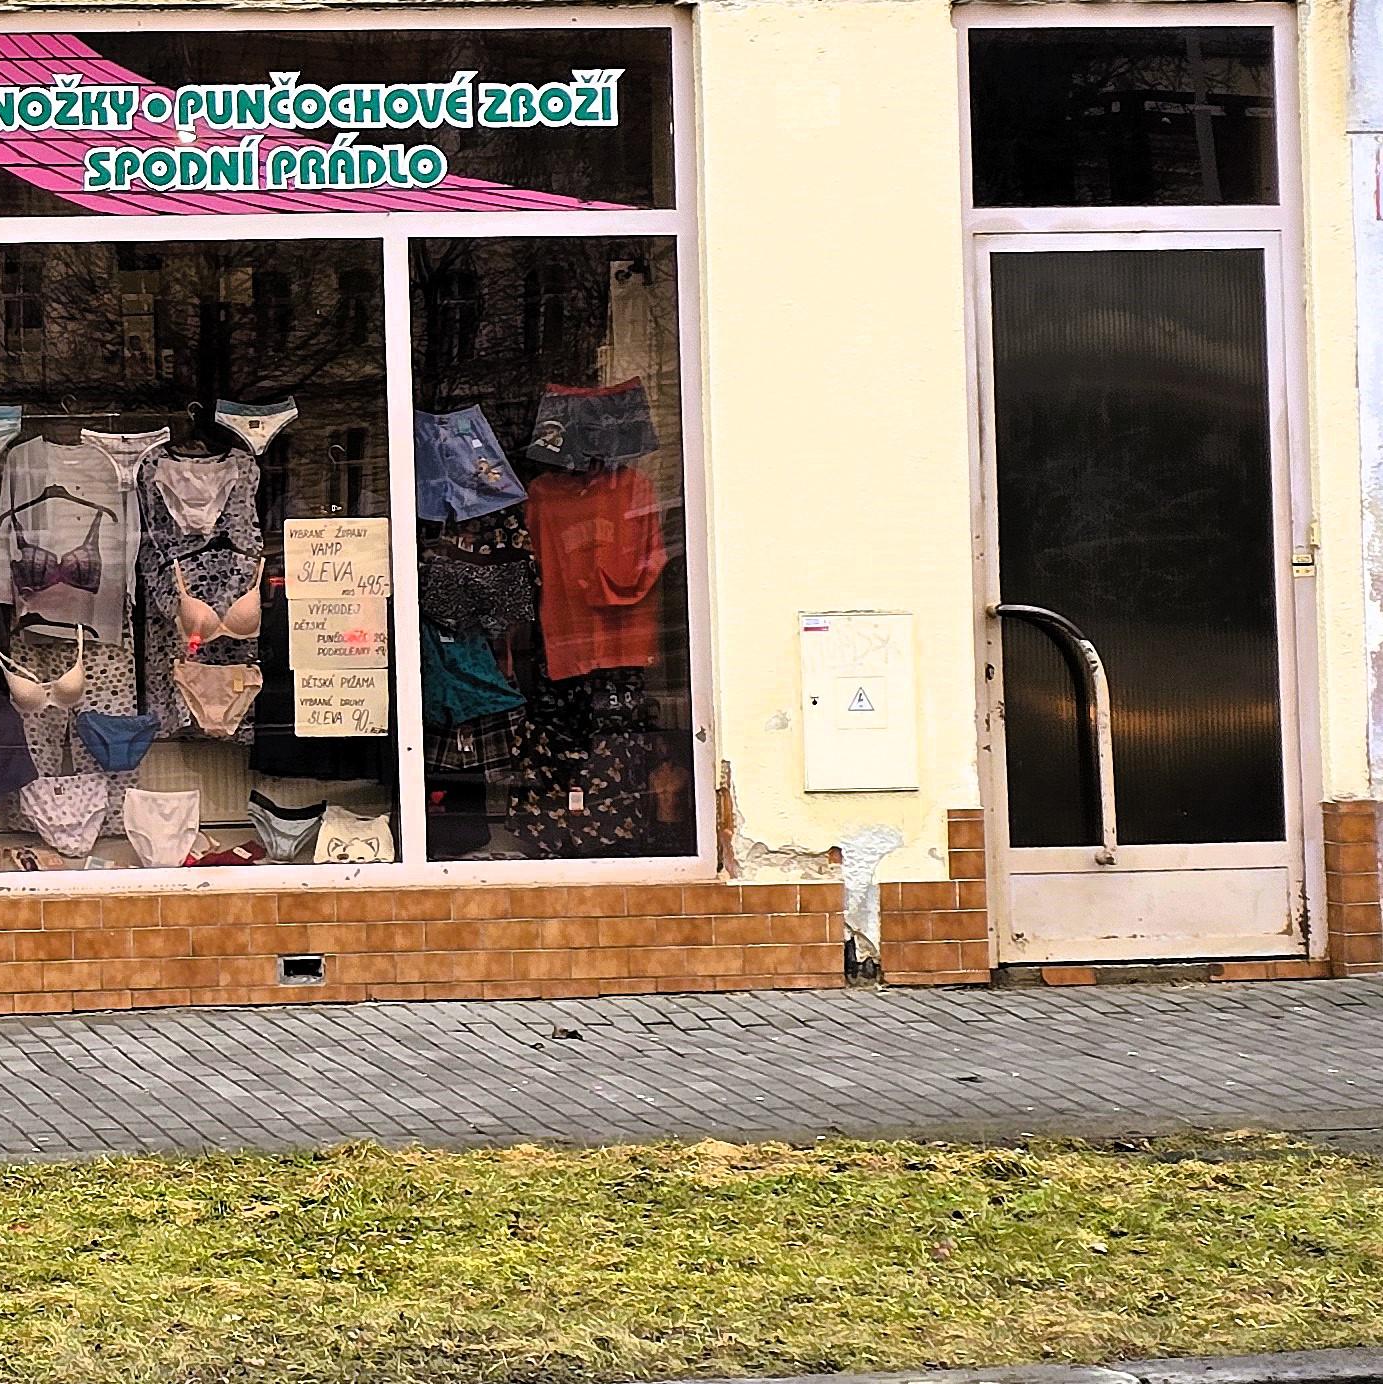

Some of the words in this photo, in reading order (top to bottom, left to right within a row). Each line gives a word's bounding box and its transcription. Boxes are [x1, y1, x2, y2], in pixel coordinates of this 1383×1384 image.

[174, 71, 478, 130] PUNČOCHOVÉ
[478, 69, 625, 128] ZBOŽÍ
[84, 134, 264, 191] SPODNÍ
[266, 132, 448, 190] PRÁDLO
[310, 542, 343, 556] VAMP
[297, 561, 354, 582] SLEVA
[308, 600, 361, 615] VÝPRODEJ
[307, 710, 343, 724] SLEVA
